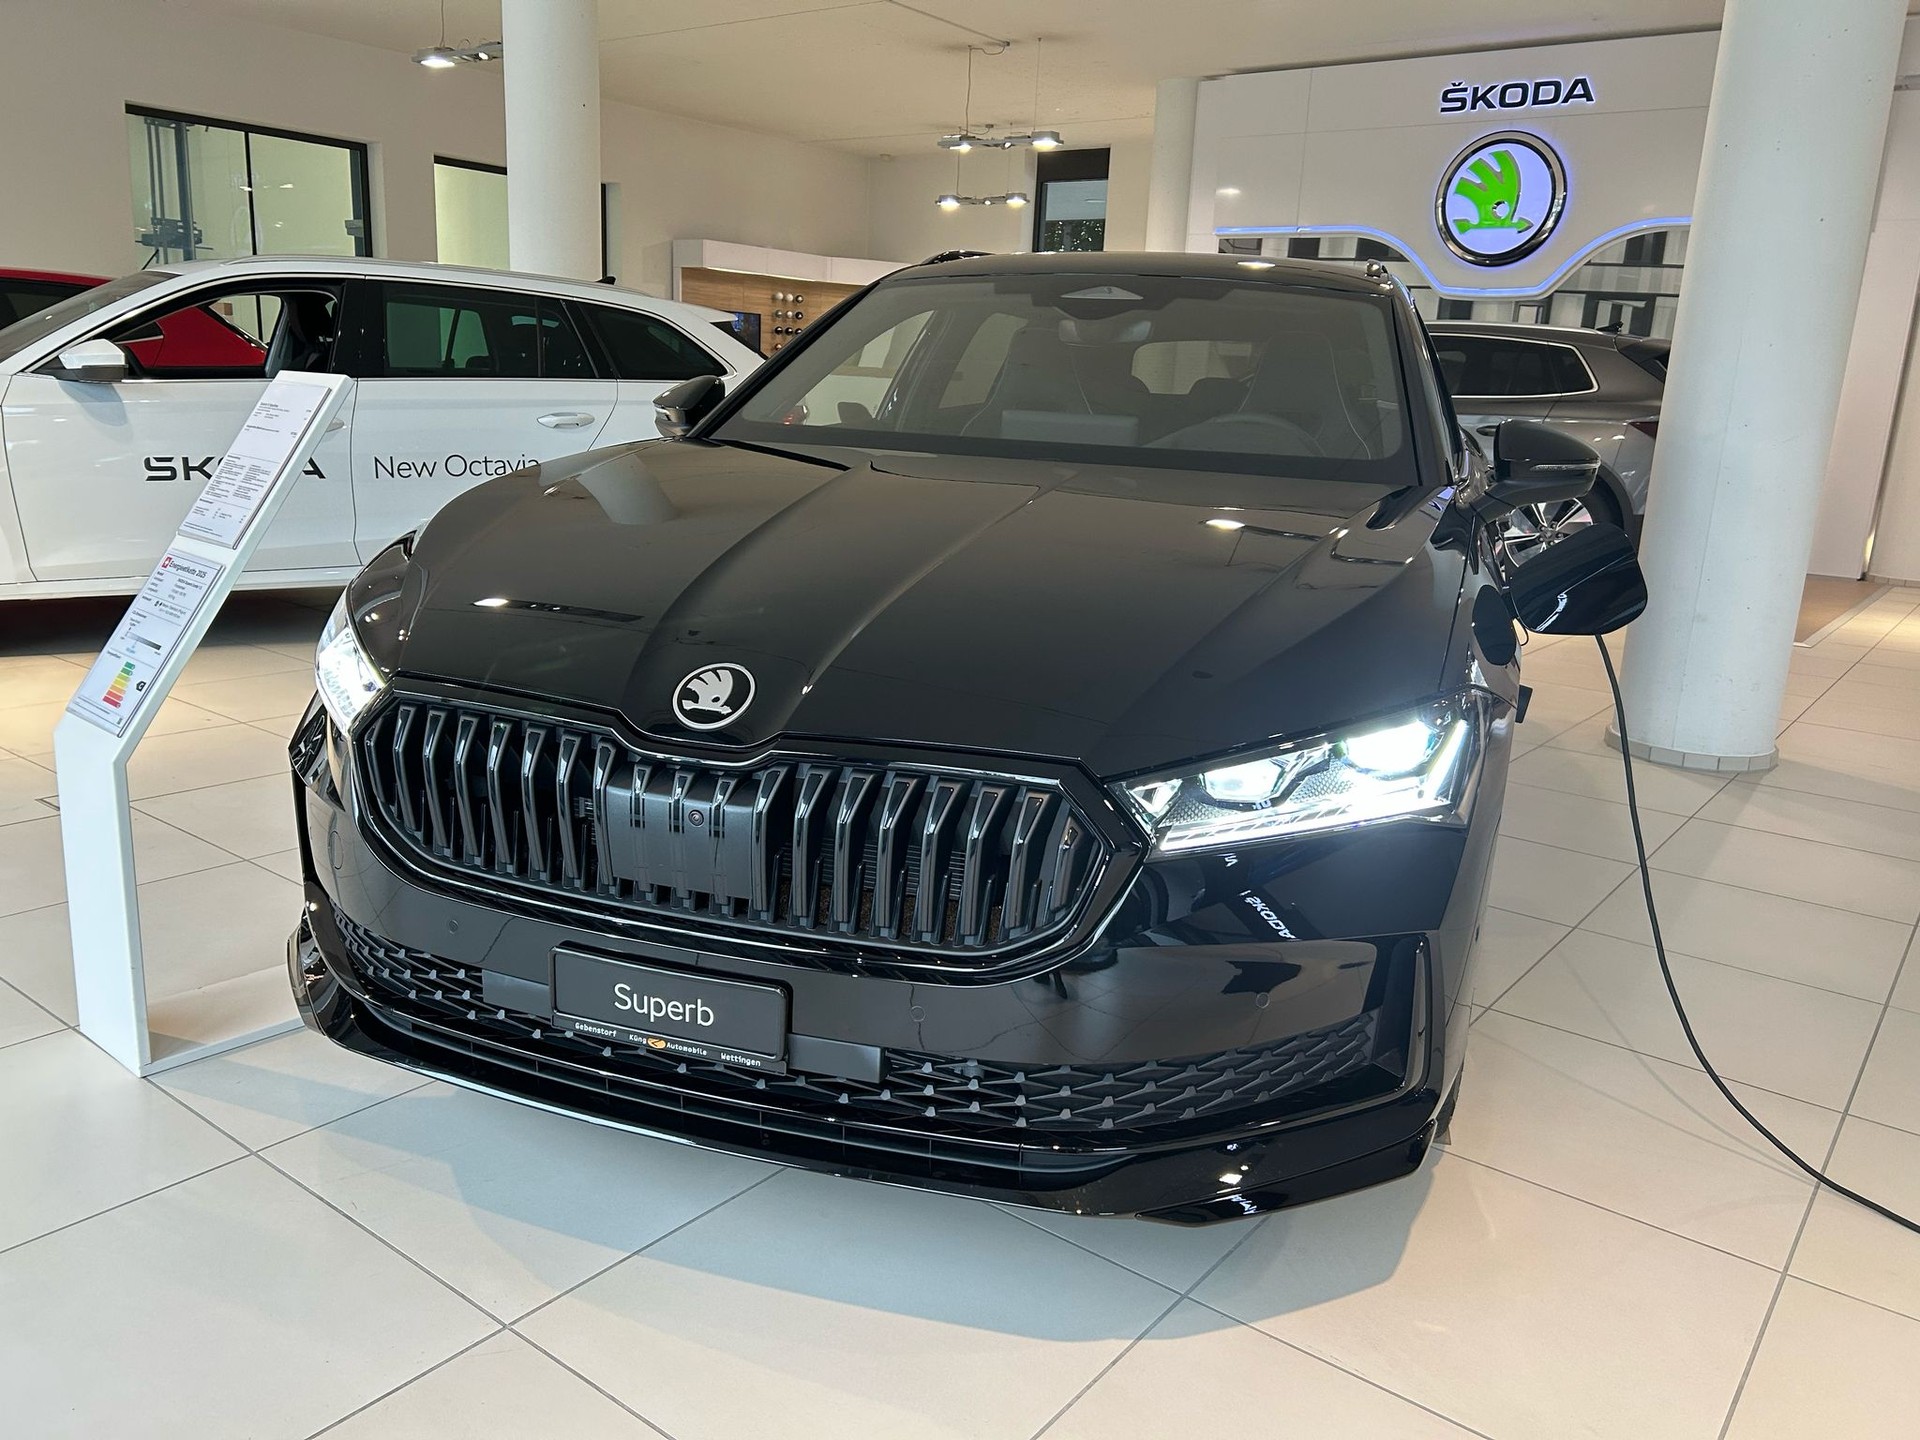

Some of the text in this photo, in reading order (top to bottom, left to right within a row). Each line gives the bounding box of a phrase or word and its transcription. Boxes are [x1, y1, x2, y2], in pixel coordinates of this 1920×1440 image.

[1440, 77, 1595, 113] ŠKODA
[143, 456, 326, 481] SKA
[374, 456, 437, 479] New
[613, 983, 714, 1027] Superb
[574, 1022, 761, 1067] Gebenstorf Küng Automobile Wettingen
